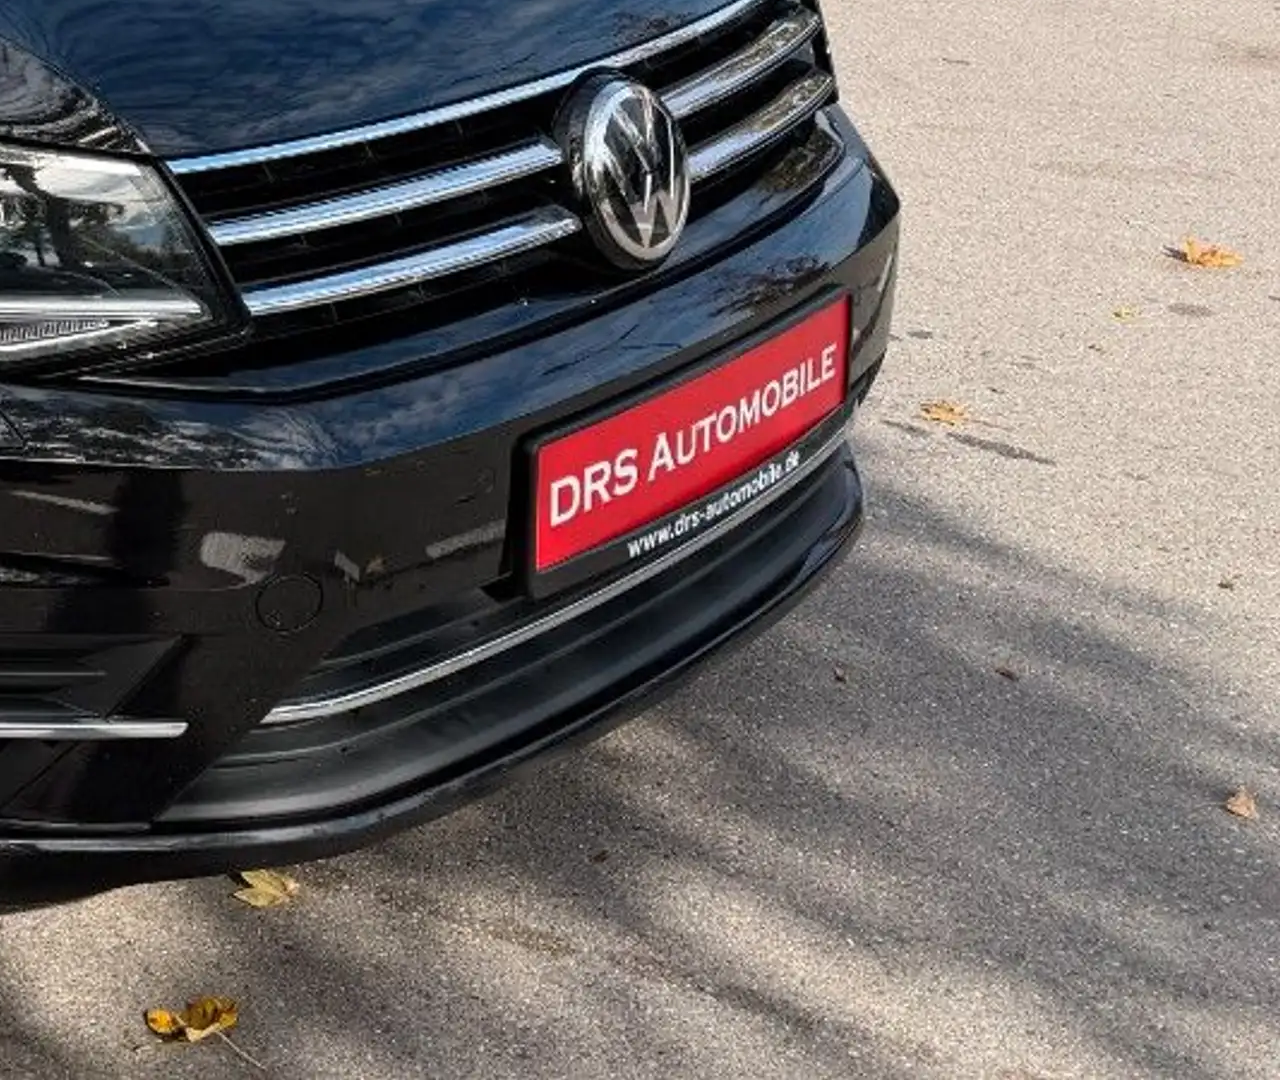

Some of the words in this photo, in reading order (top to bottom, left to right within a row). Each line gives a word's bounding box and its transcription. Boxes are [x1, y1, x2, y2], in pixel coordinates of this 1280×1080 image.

[549, 448, 638, 527] DRS
[647, 342, 838, 482] AUTOMOBILE
[627, 450, 800, 558] www.drs-automobile.de
